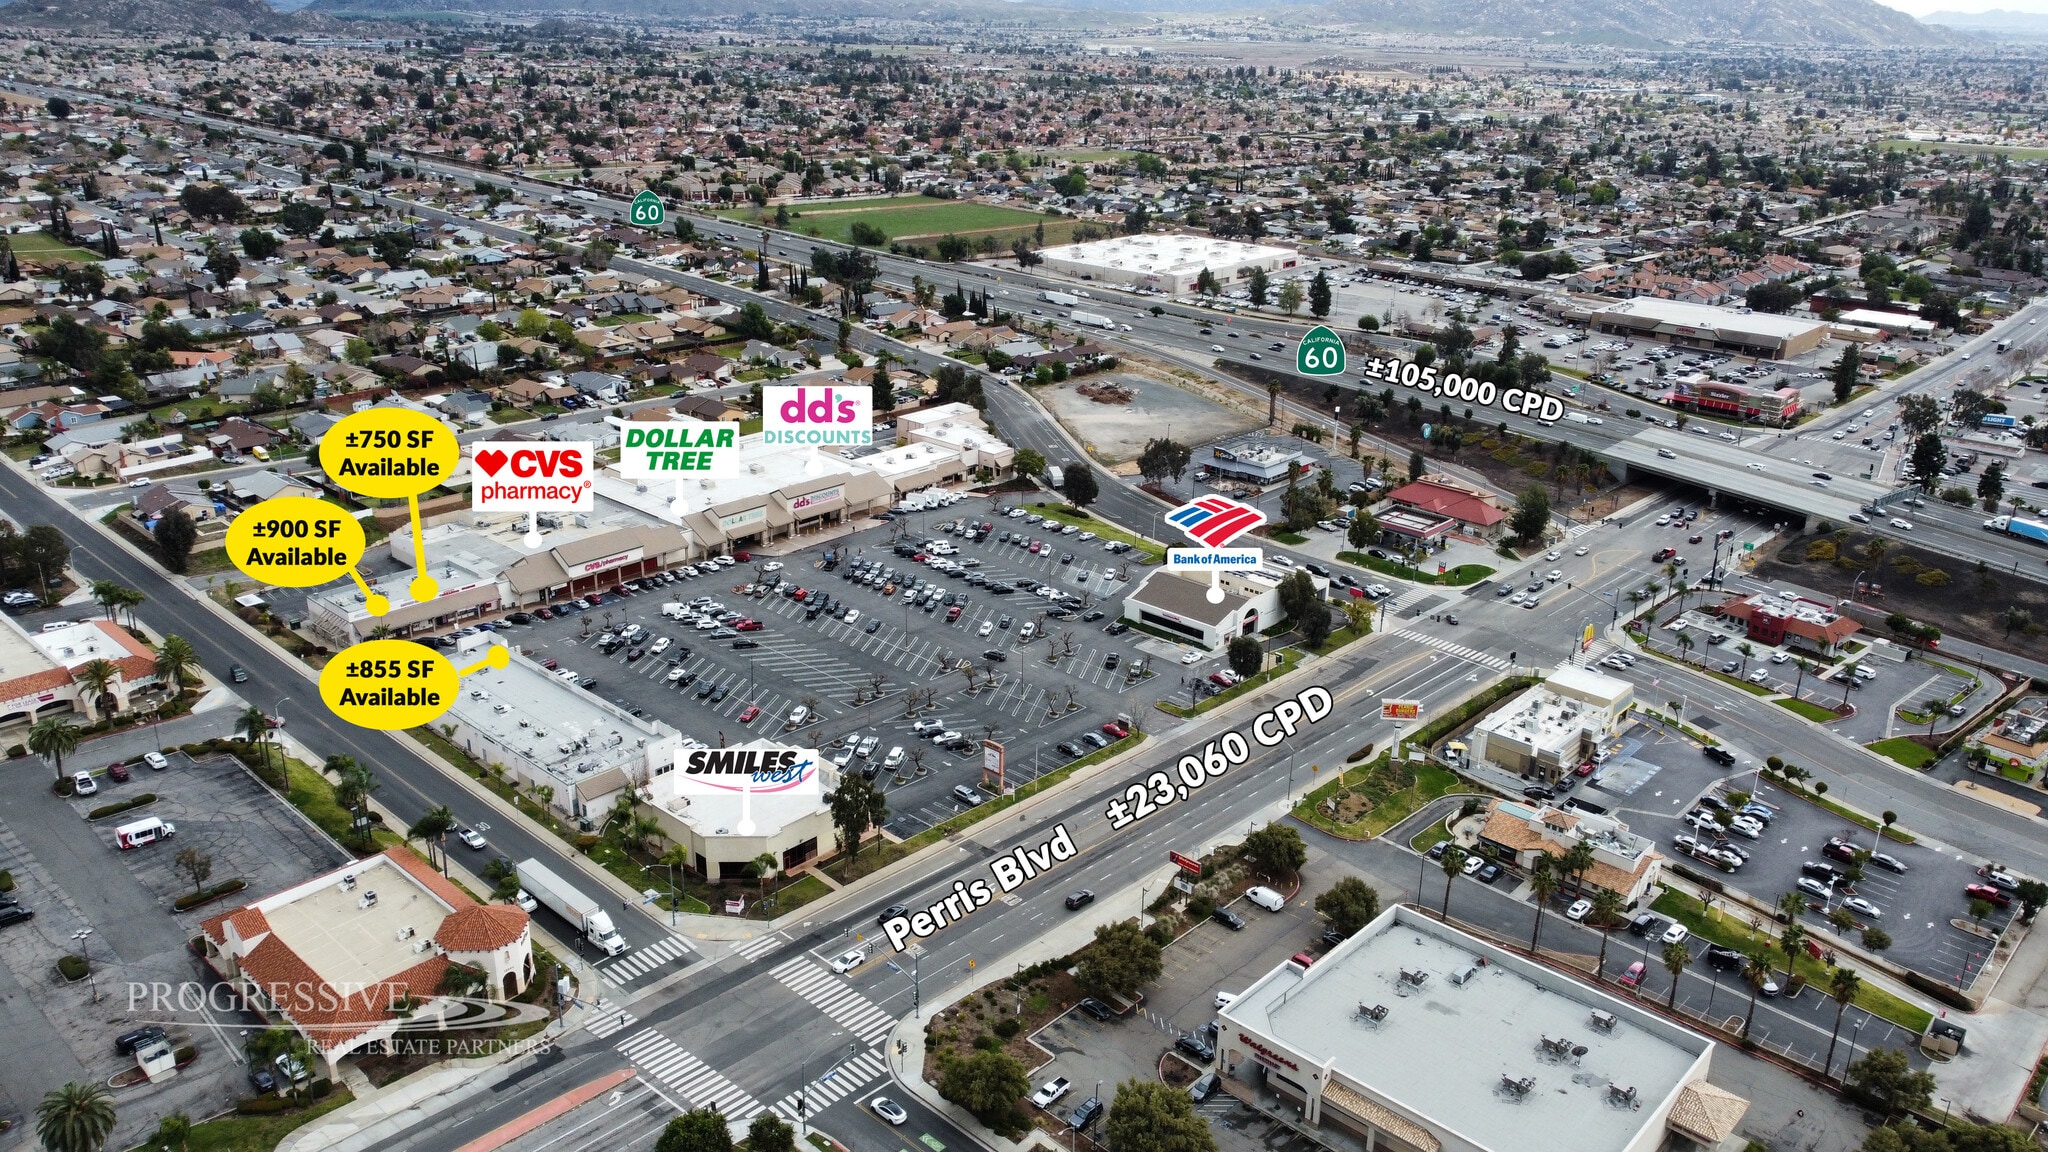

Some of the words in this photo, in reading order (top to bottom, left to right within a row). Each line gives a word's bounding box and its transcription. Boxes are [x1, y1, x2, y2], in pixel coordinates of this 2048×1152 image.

[793, 497, 811, 509] dd's
[810, 488, 840, 501] DISCOUNTS
[475, 821, 491, 831] 30
[1238, 1032, 1300, 1072] Walgreens
